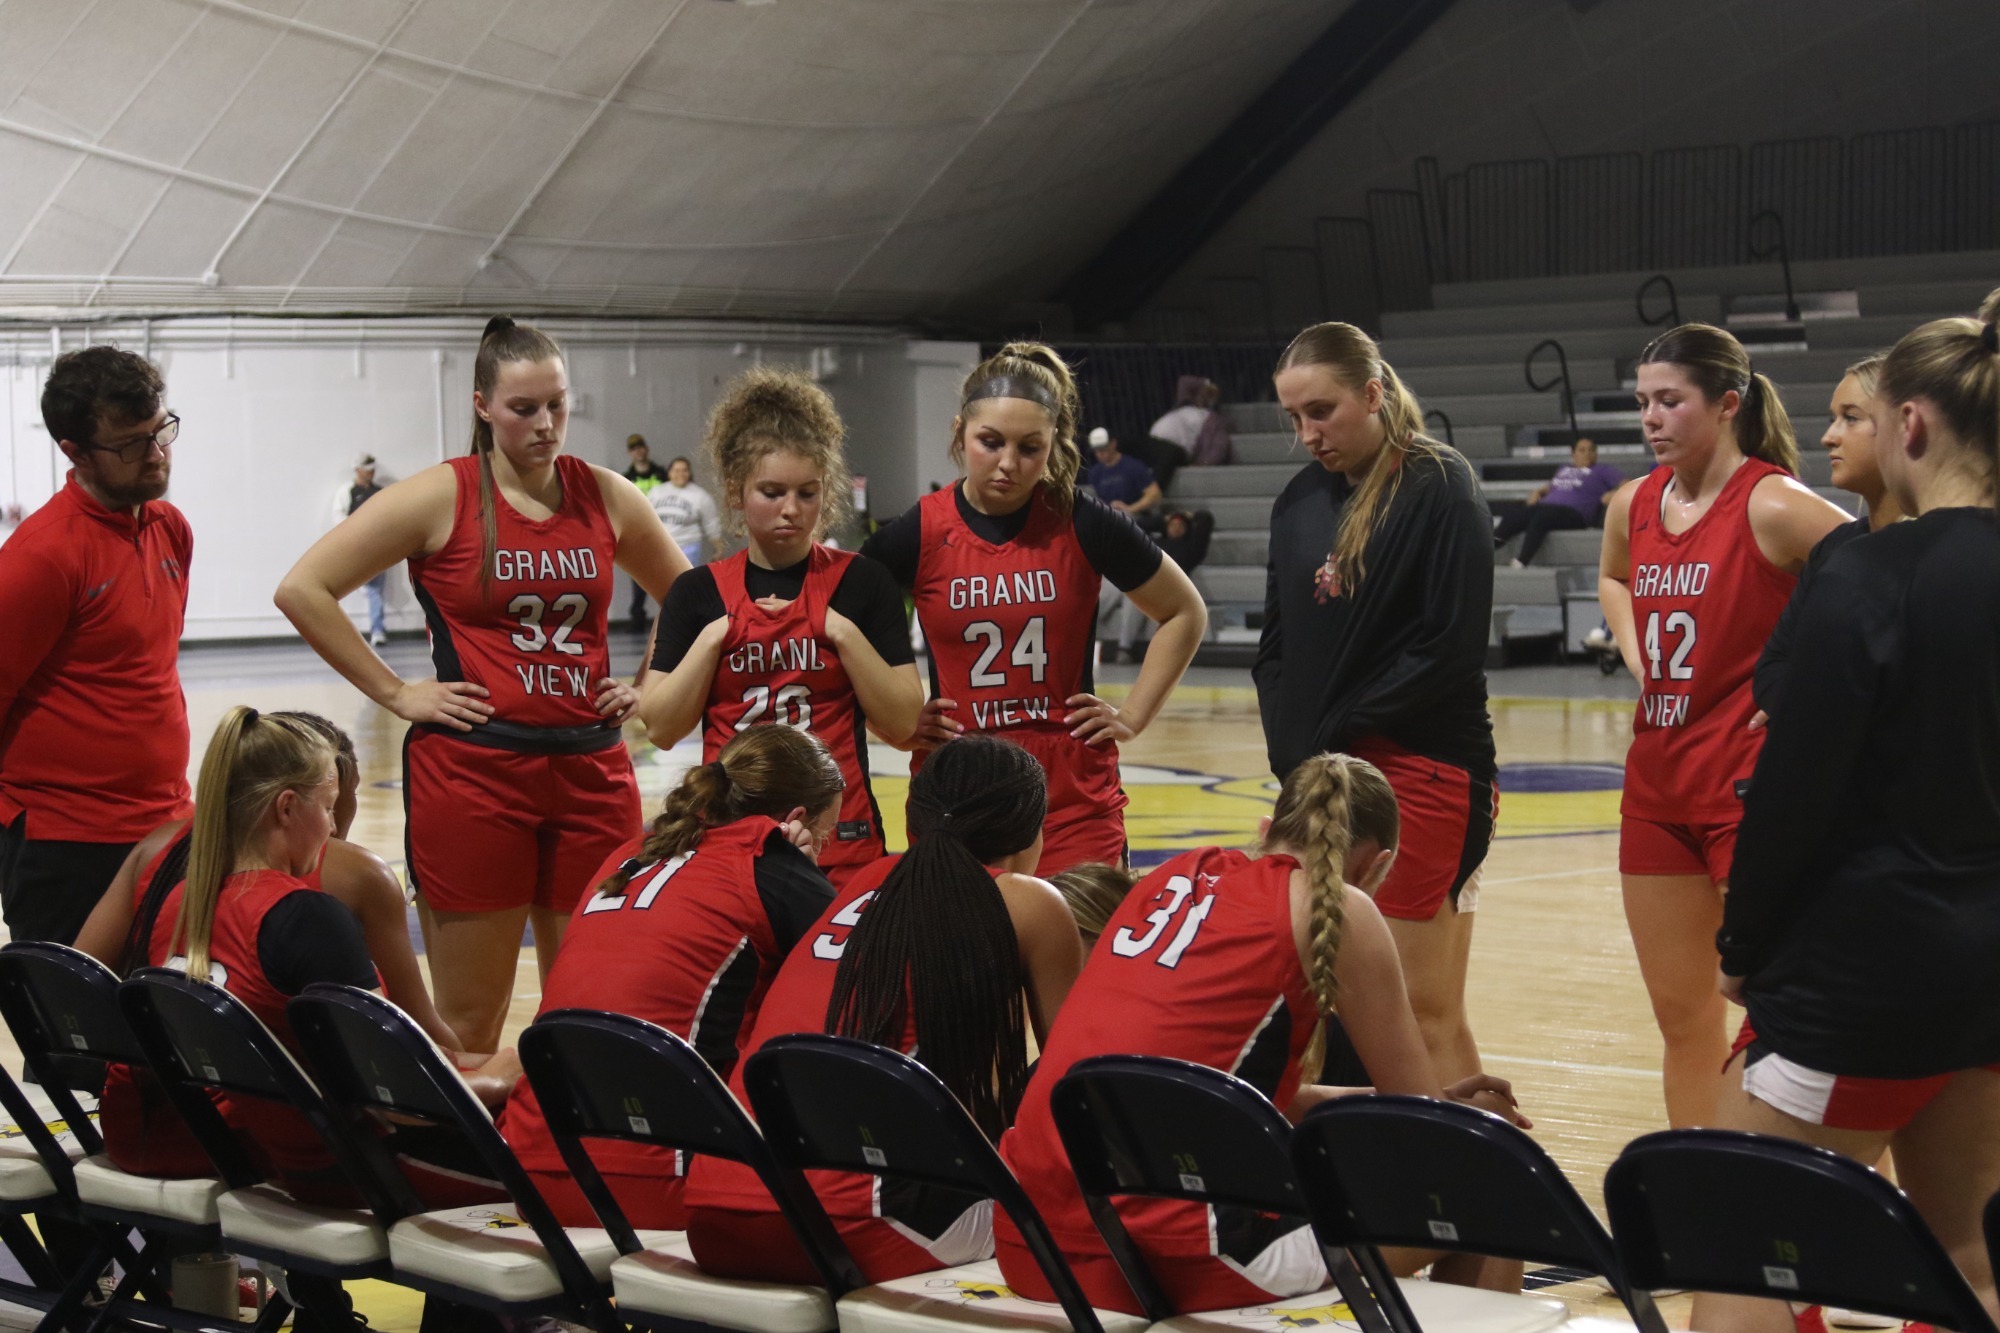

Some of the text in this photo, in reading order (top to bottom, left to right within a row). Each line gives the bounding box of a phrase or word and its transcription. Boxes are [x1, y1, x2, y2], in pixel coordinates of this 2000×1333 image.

[495, 547, 598, 581] GRAND
[1634, 563, 1710, 598] GRAND
[949, 569, 1057, 610] GRAND
[508, 593, 589, 655] 32
[963, 616, 1048, 688] 24
[1645, 611, 1698, 681] 42
[516, 664, 589, 697] VIEW
[733, 684, 812, 731] 20
[970, 696, 1049, 730] VIEW
[859, 825, 868, 834] M
[1112, 874, 1216, 969] 31
[1774, 1238, 1799, 1264] 19
